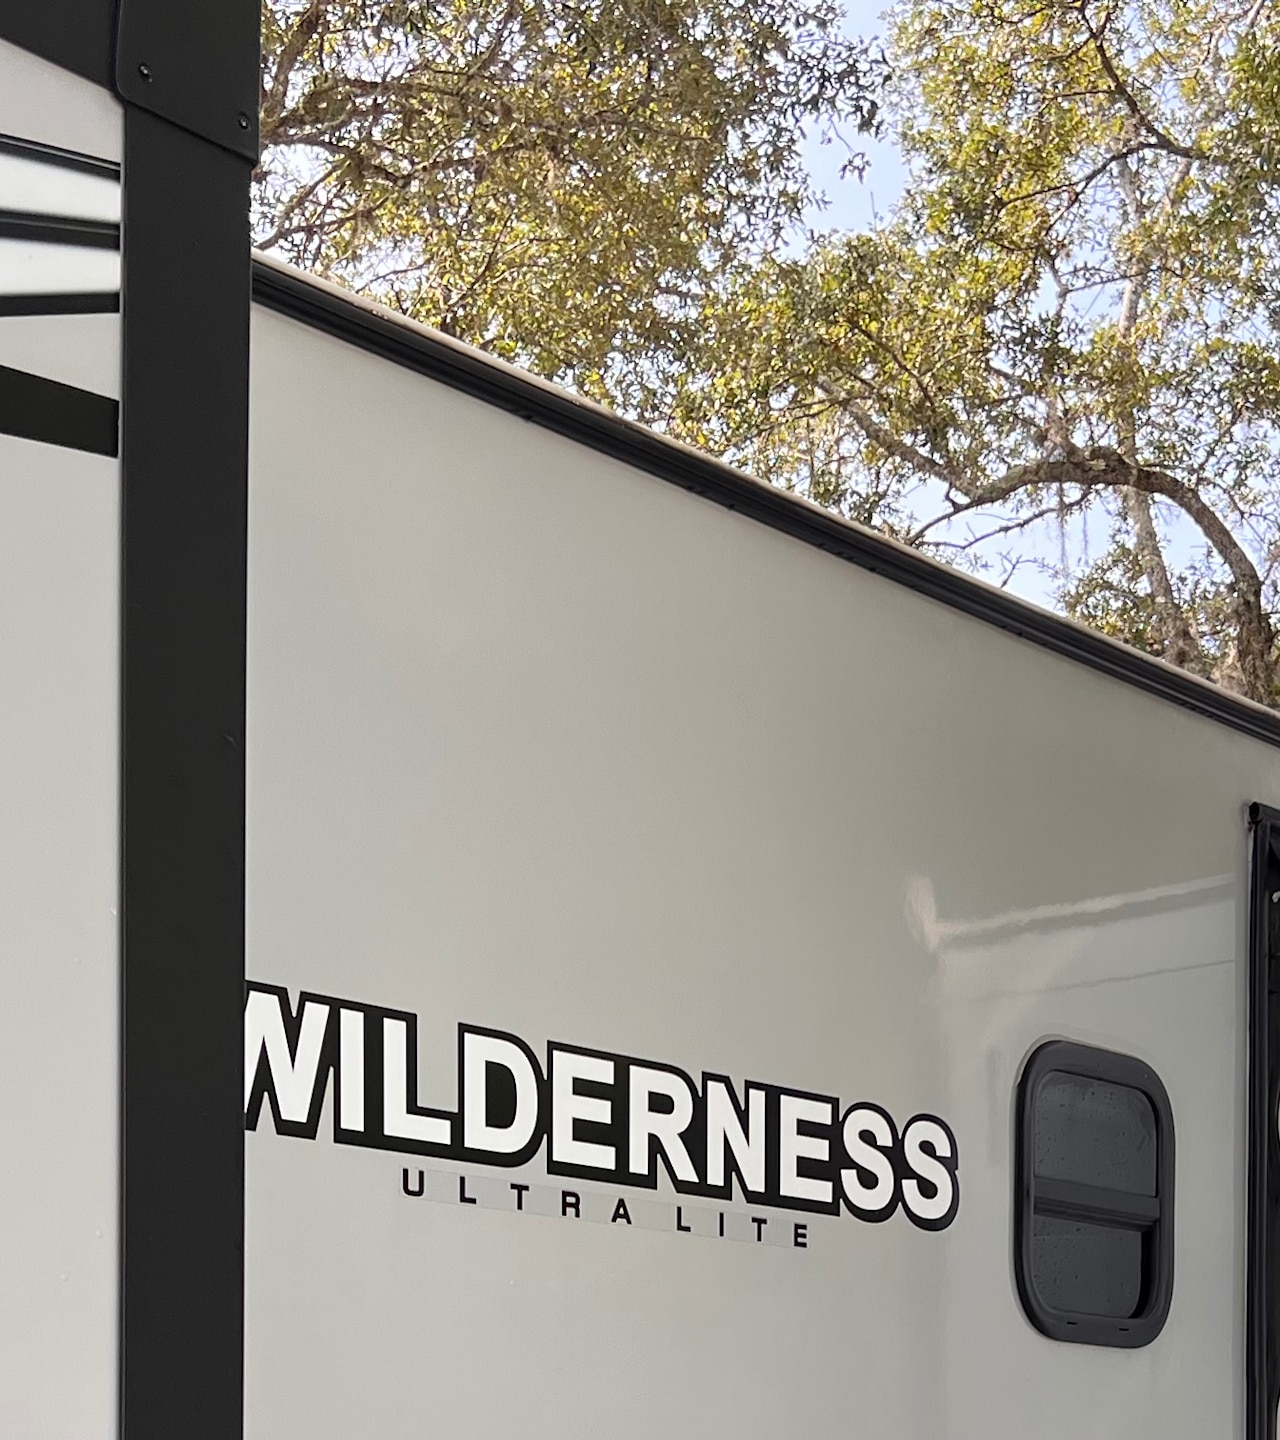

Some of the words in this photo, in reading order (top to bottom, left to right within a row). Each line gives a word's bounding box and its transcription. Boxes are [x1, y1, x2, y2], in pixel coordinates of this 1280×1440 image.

[244, 980, 959, 1232] WILDERNESS
[402, 1167, 632, 1226] ULTRA
[676, 1205, 808, 1249] LITE
